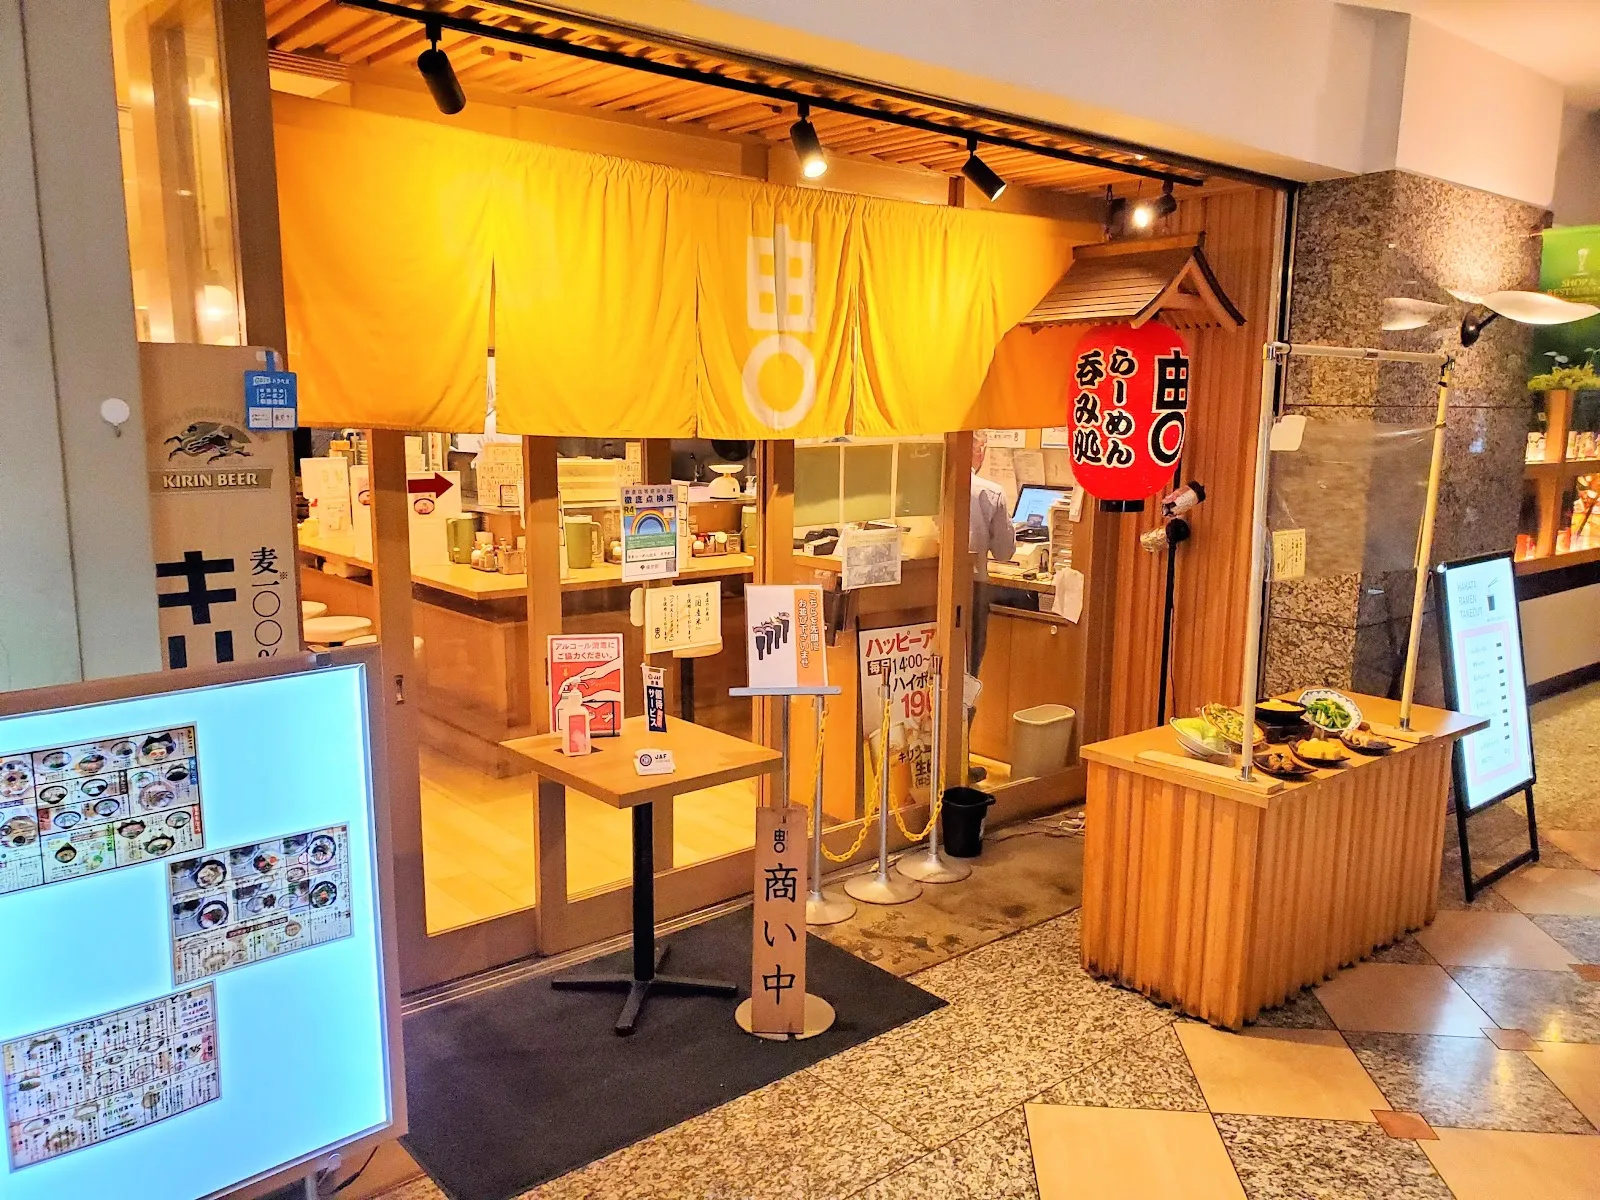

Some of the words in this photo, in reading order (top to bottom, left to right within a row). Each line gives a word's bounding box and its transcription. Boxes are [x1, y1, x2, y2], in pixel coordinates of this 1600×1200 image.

[1561, 278, 1588, 287] SHOP
[1074, 349, 1103, 464] 呑み処
[1106, 348, 1136, 466] らーめん
[162, 474, 213, 489] KIRIN
[217, 472, 259, 488] BEER
[1458, 594, 1477, 606] RAMEN
[555, 642, 615, 650] アルコール消毒に
[557, 652, 613, 660] ご協力ください。
[648, 688, 657, 727] サービス
[762, 862, 799, 1005] 商い中
